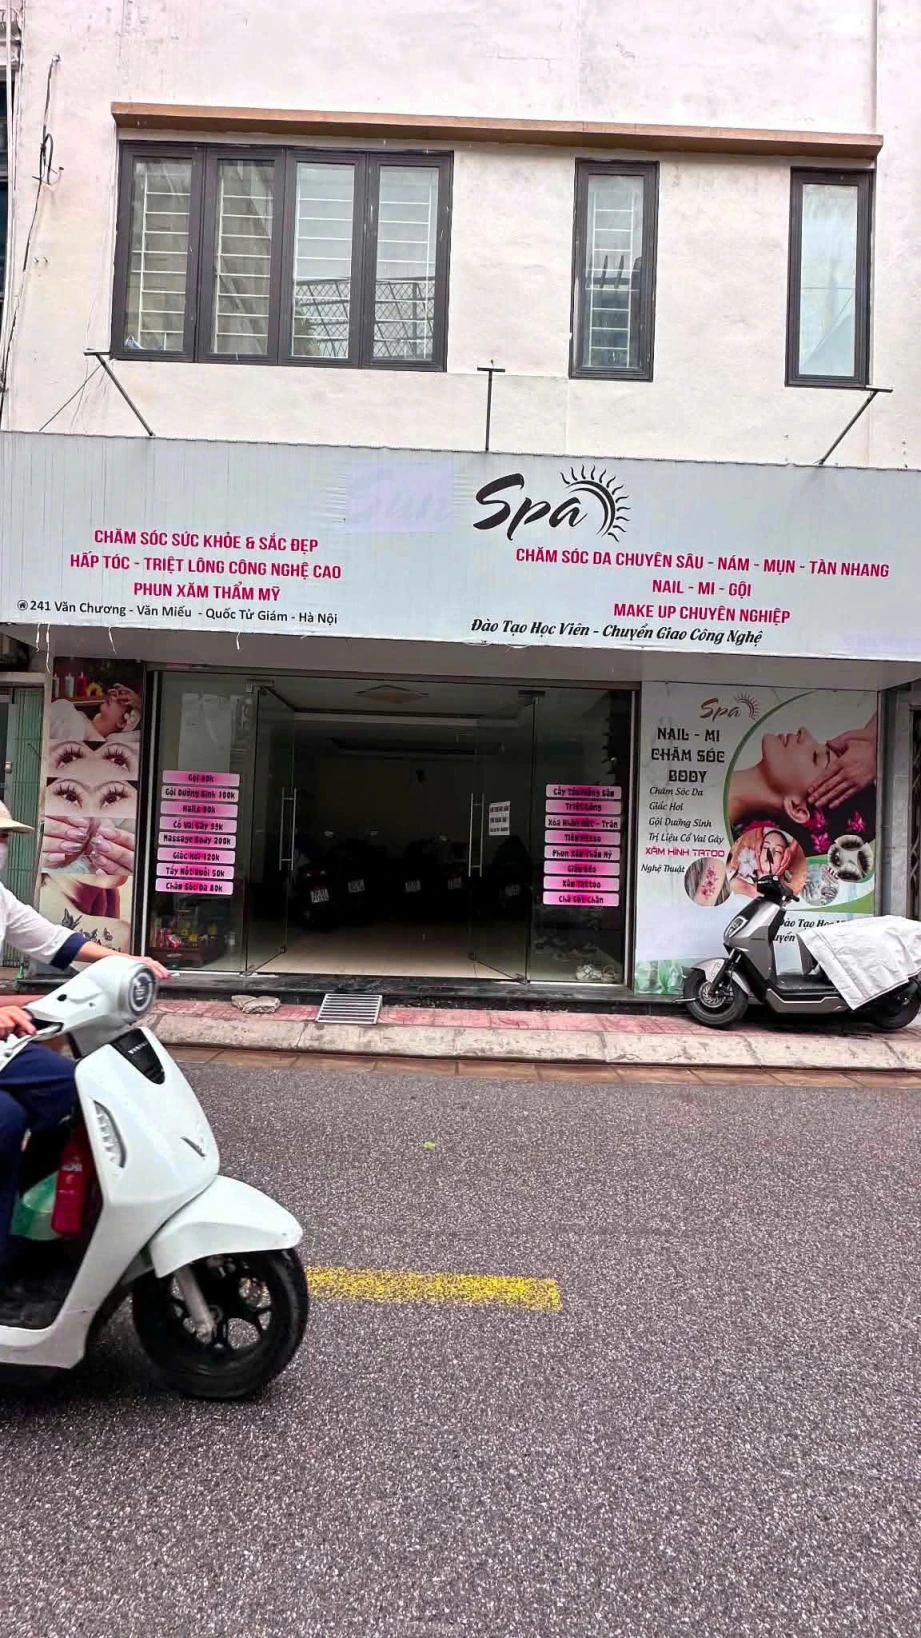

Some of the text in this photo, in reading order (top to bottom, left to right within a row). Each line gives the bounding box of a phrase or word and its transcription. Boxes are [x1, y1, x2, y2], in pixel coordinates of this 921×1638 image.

[472, 472, 588, 541] Spa
[94, 528, 319, 555] CHĂM SÓC SỨC KHỎE & SẮC ĐẸP
[70, 551, 99, 569] HẤP
[102, 554, 130, 570] TÓC
[144, 556, 184, 574] TRIỆT
[188, 557, 225, 574] LÔNG
[228, 559, 267, 576] CÔNG
[271, 561, 309, 580] NGHỆ
[313, 565, 341, 579] CAO
[516, 546, 557, 563] CHĂM
[561, 547, 588, 564] SÓC
[593, 551, 611, 566] DA
[615, 551, 672, 568] CHUYÊN
[676, 553, 704, 569] SÂU
[717, 554, 750, 572] NÁM
[763, 558, 796, 576] MỤN
[809, 558, 837, 575] TÀN
[840, 562, 890, 578] NHANG
[133, 581, 281, 601] PHUN XĂM THẨM MỸ
[652, 579, 685, 594] NAIL
[698, 581, 715, 595] MI
[728, 580, 752, 599] GỘI
[30, 600, 51, 611] 241
[54, 600, 76, 613] Văn
[79, 602, 126, 617] Chương
[136, 605, 158, 617] Văn
[161, 605, 192, 618] Miếu
[205, 607, 236, 620] Quốc
[239, 608, 255, 620] Tử
[257, 609, 288, 622] Giám
[299, 611, 314, 623] Hà
[317, 612, 338, 626] Nội
[613, 603, 791, 626] MAKE UP CHUYÊN NGHIỆP
[471, 618, 499, 632] Đào
[502, 620, 528, 637] Tạo
[530, 621, 556, 638] Học
[559, 622, 590, 636] Viên
[602, 623, 654, 641] Chuyển
[656, 626, 688, 641] Giao
[690, 627, 725, 644] Công
[726, 629, 763, 647] Nghệ
[700, 697, 740, 722] Spa
[657, 727, 690, 741] NAIL
[704, 729, 720, 742] MI
[651, 746, 725, 763] CHĂM SÓC
[668, 769, 708, 783] BODY
[649, 786, 704, 796] Chăm Sóc Da
[648, 817, 712, 828] Gội Dưỡng Sinh
